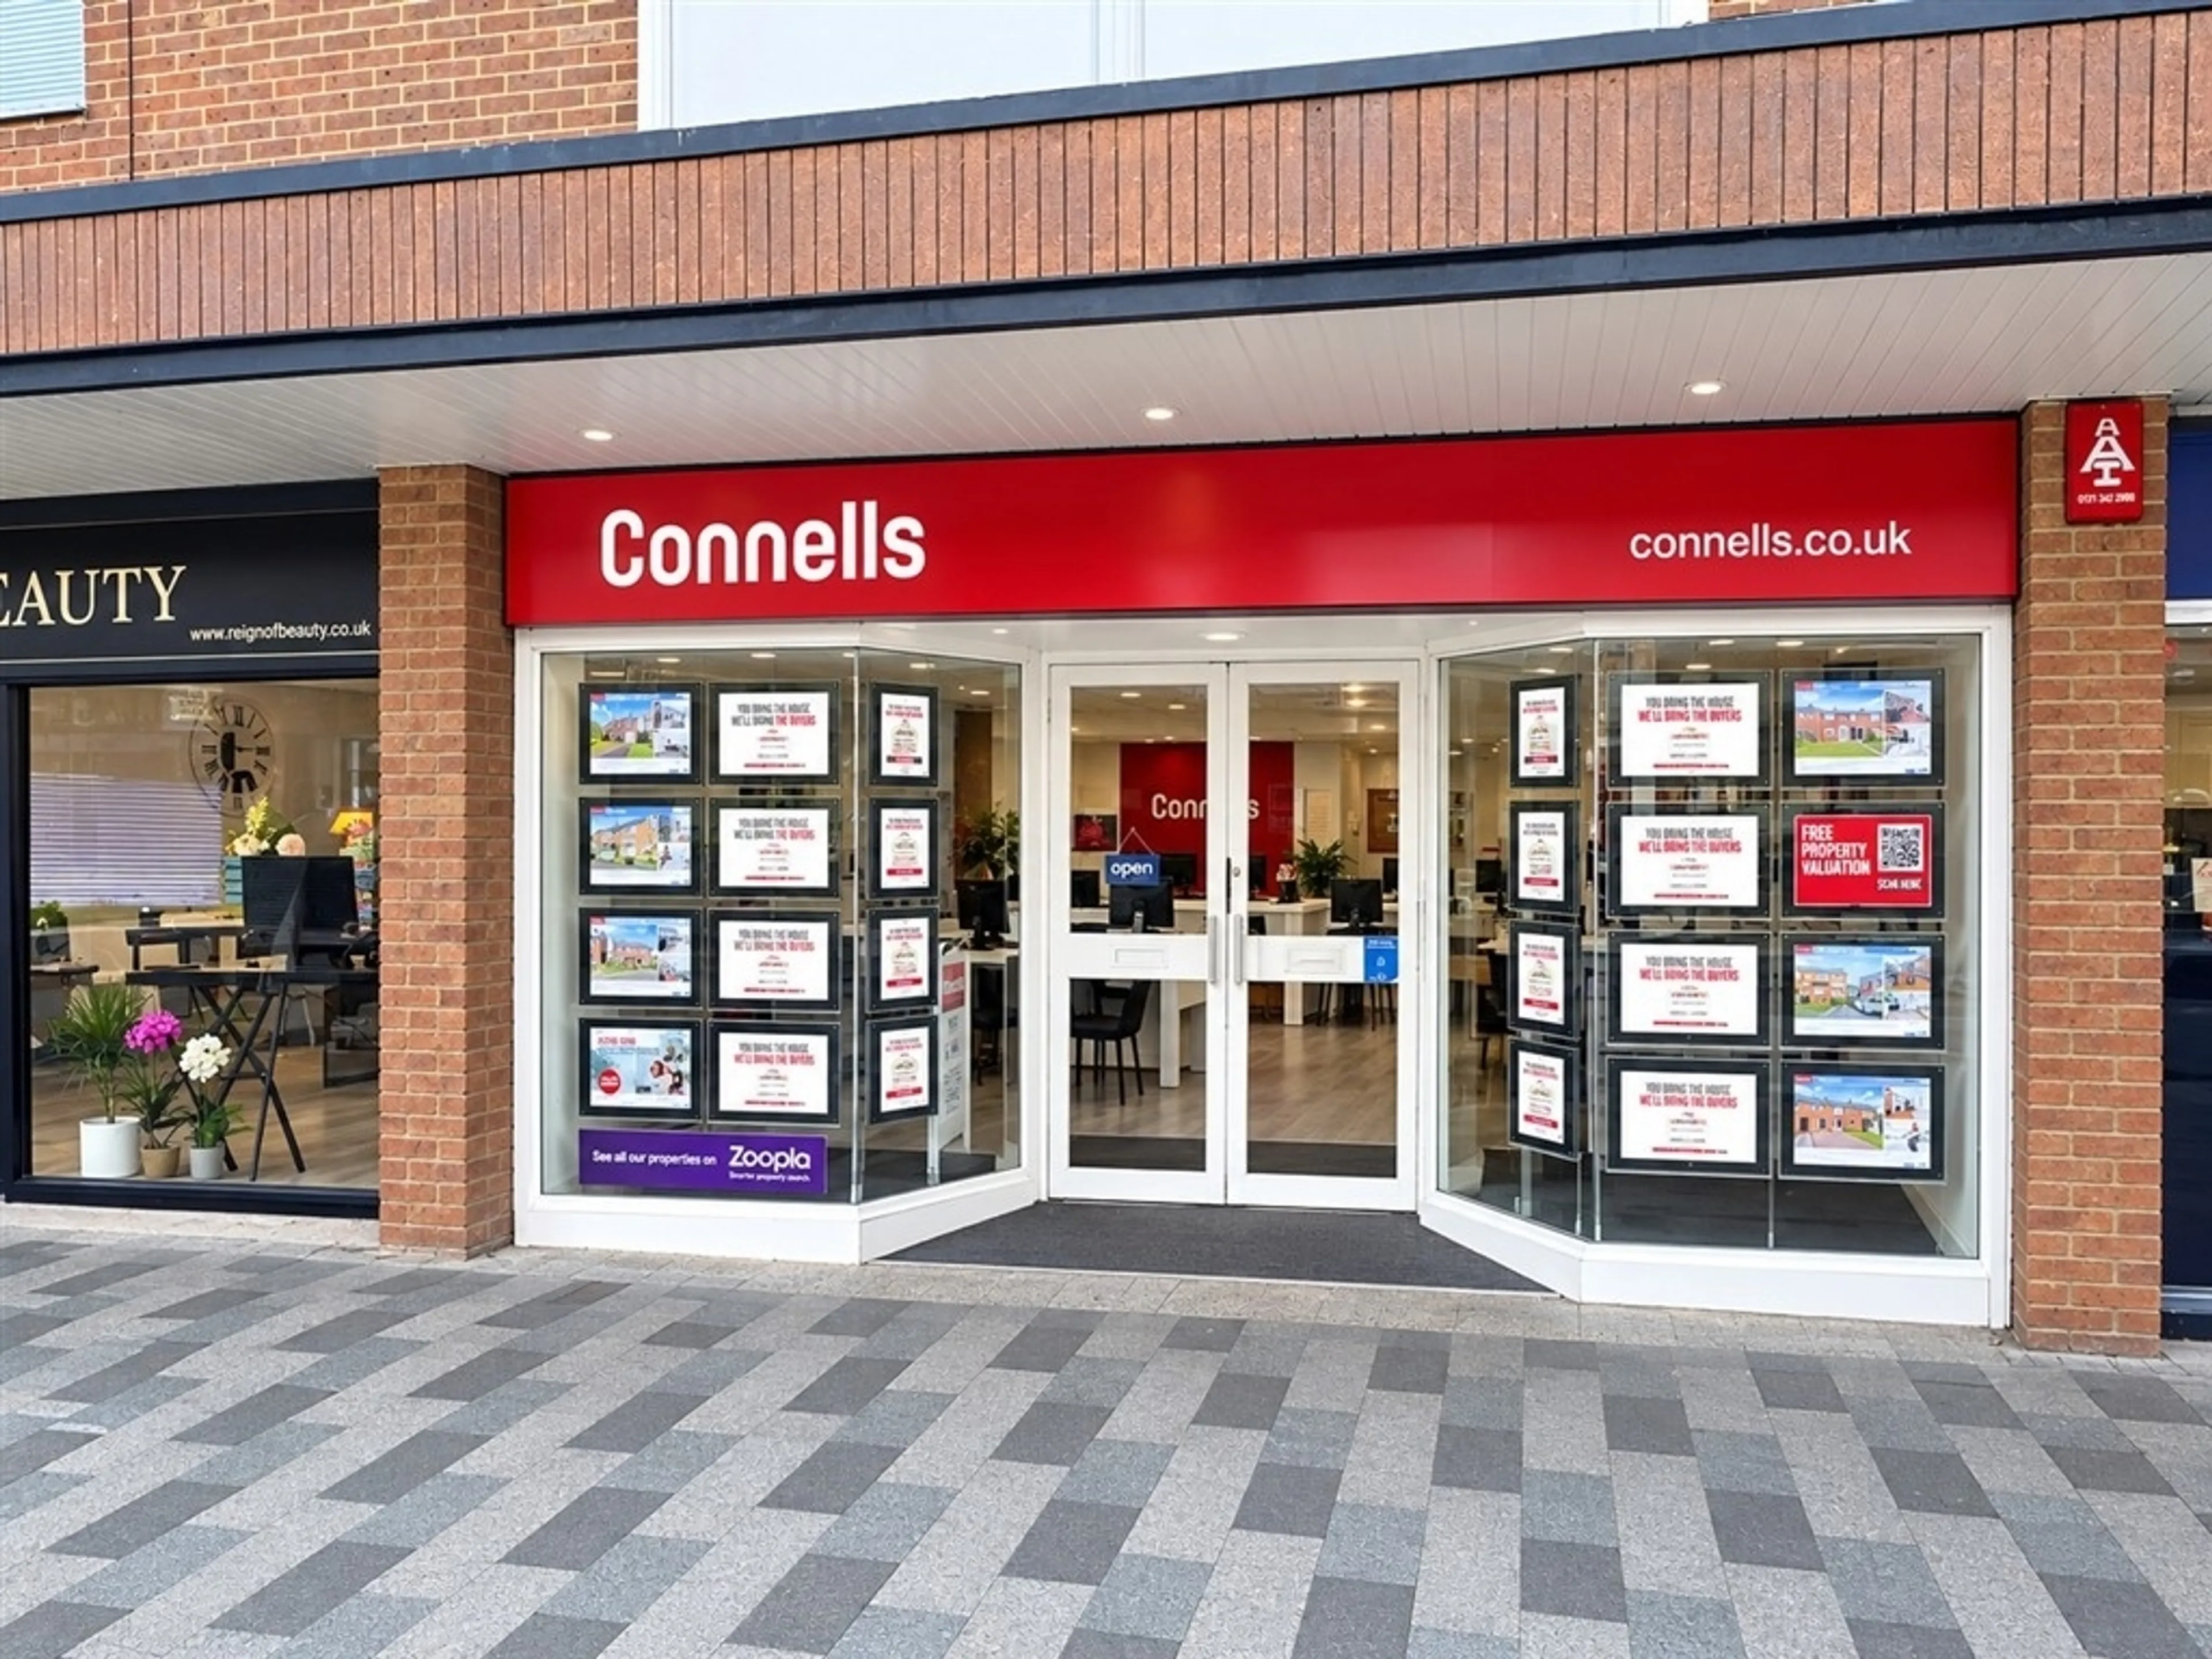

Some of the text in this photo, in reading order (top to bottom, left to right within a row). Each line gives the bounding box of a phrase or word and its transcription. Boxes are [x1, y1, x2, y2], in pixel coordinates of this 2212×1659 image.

[600, 499, 926, 588] Connells
[1630, 520, 1912, 559] connells.co.uk
[190, 620, 372, 643] www.reignofbeauty.co.uk
[1152, 793, 1260, 820] Conns
[1801, 824, 1834, 841] FREE
[1801, 842, 1867, 858] PROPERTY
[1110, 862, 1153, 878] open
[1801, 859, 1871, 876] VALUATION
[592, 1150, 717, 1166] See all our properties on
[728, 1145, 811, 1172] Zoopla
